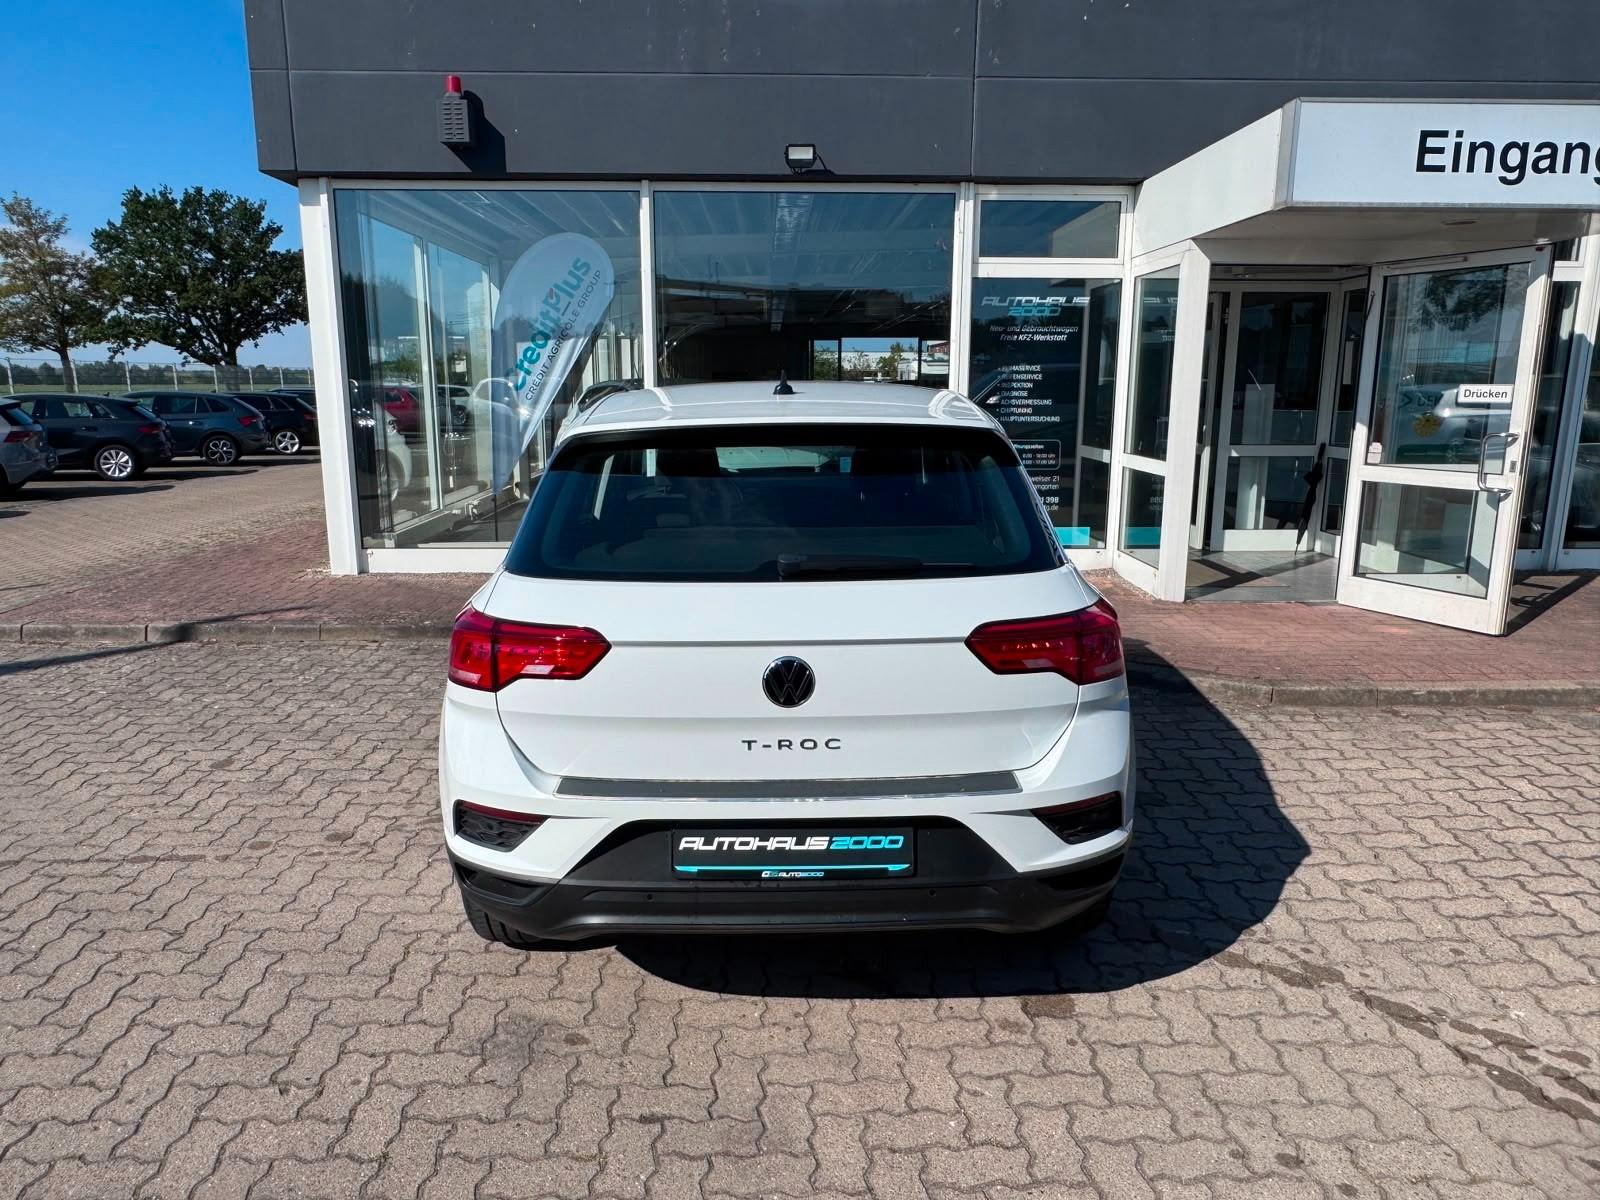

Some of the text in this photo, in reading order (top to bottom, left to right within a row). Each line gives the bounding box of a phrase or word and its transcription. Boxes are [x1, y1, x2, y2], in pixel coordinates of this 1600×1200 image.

[981, 296, 1091, 306] AUTOHAUS
[1008, 306, 1061, 316] 2000
[1022, 325, 1079, 333] Gebrauchtwagen
[525, 269, 602, 401] CREDIT AGRICOLE GROUP
[1463, 388, 1508, 399] Drücken
[741, 738, 842, 751] T-ROC
